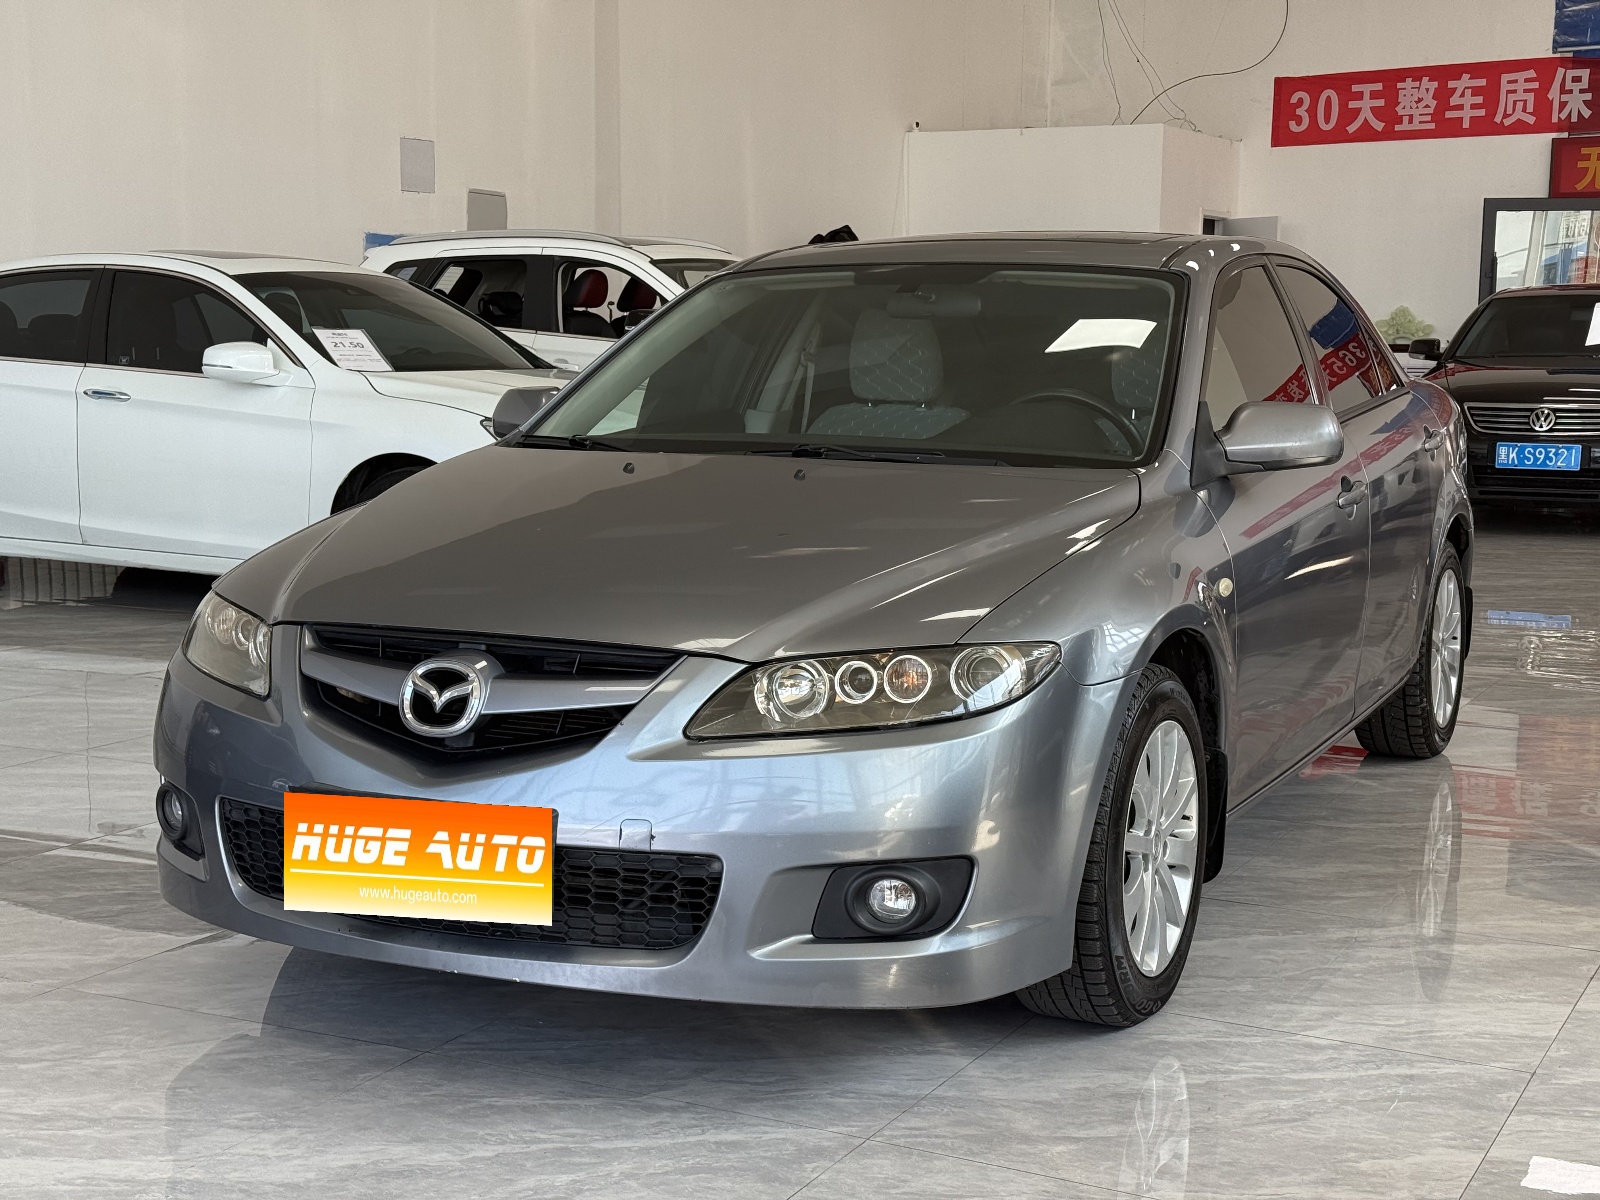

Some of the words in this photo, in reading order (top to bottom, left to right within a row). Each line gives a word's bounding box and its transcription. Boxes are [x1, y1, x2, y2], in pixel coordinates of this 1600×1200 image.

[1288, 66, 1593, 135] 30天整车质保
